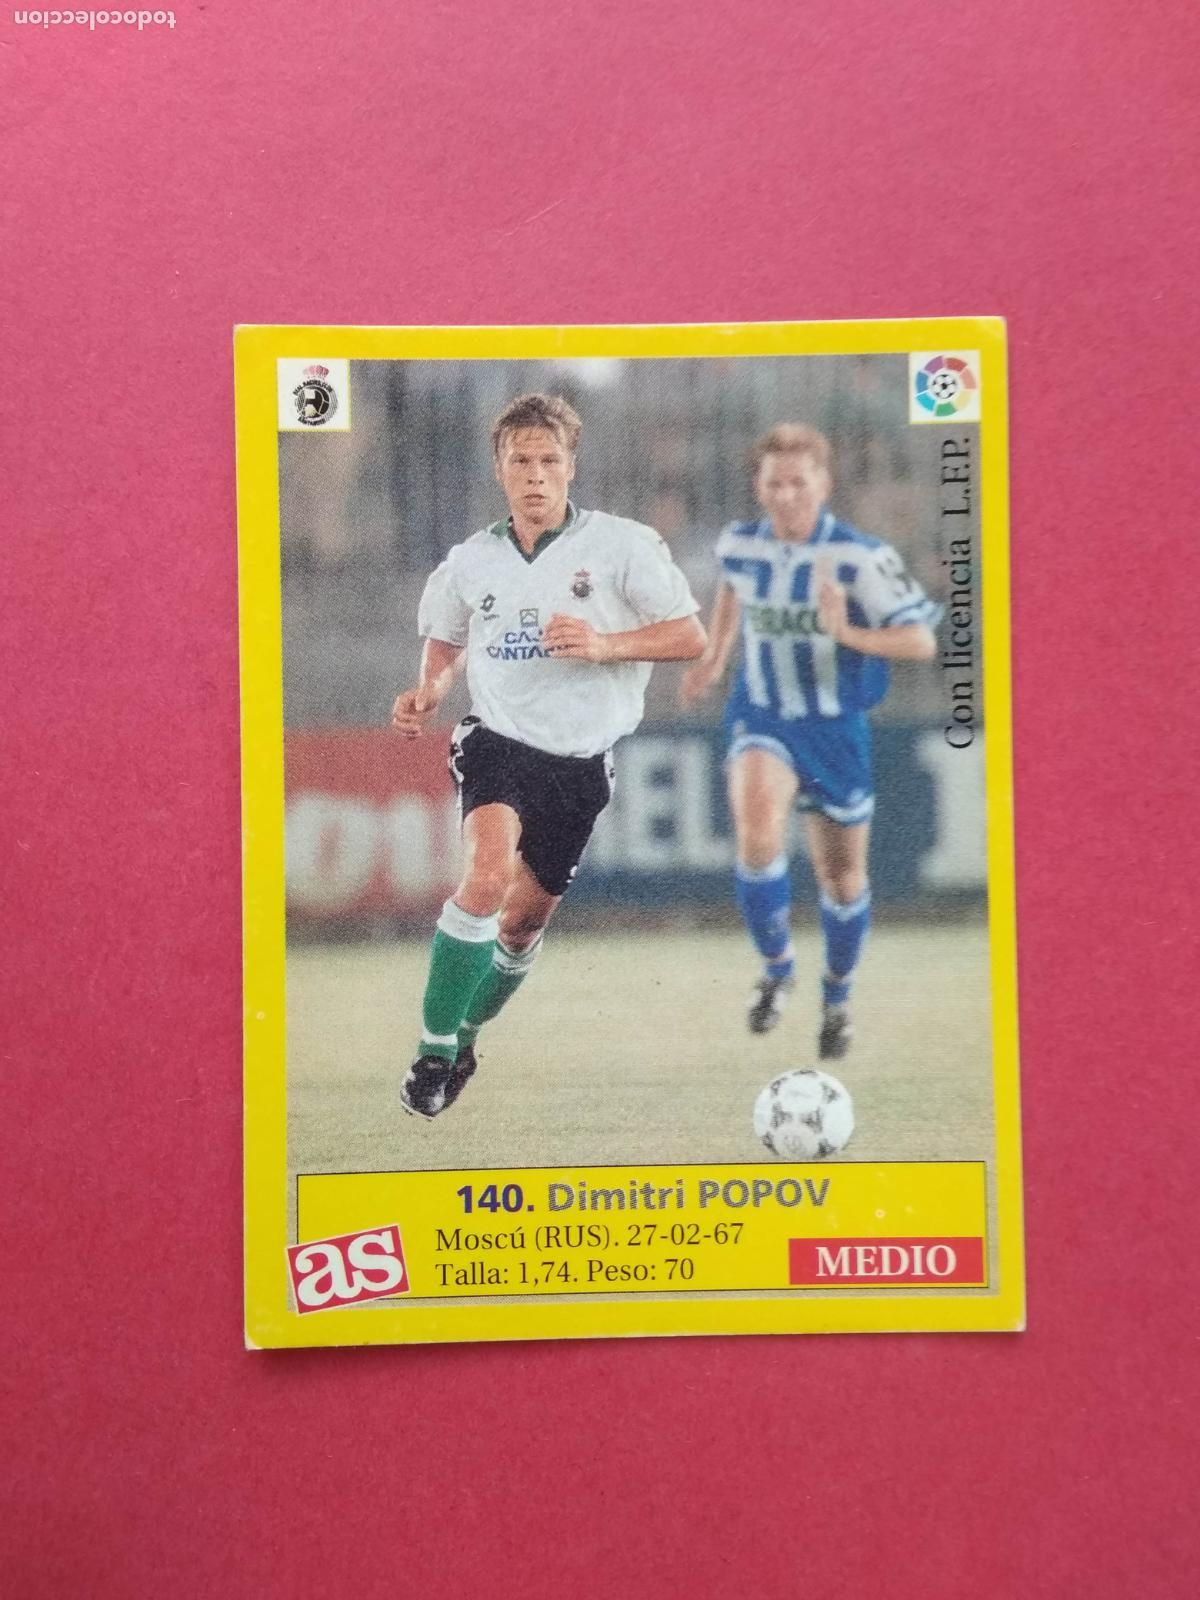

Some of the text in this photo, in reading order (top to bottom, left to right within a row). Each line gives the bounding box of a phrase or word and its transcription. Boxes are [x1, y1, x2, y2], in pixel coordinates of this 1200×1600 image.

[941, 436, 972, 517] L.F.P.
[943, 536, 974, 671] licencia
[944, 680, 975, 750] Con
[457, 1177, 831, 1214] 140. Dimitri POPOV
[435, 1222, 745, 1252] Moscú (RUS). 27-02-67
[815, 1244, 957, 1277] MEDIO
[295, 1230, 404, 1307] as
[435, 1258, 695, 1287] Talla: 1,74. Peso: 70
